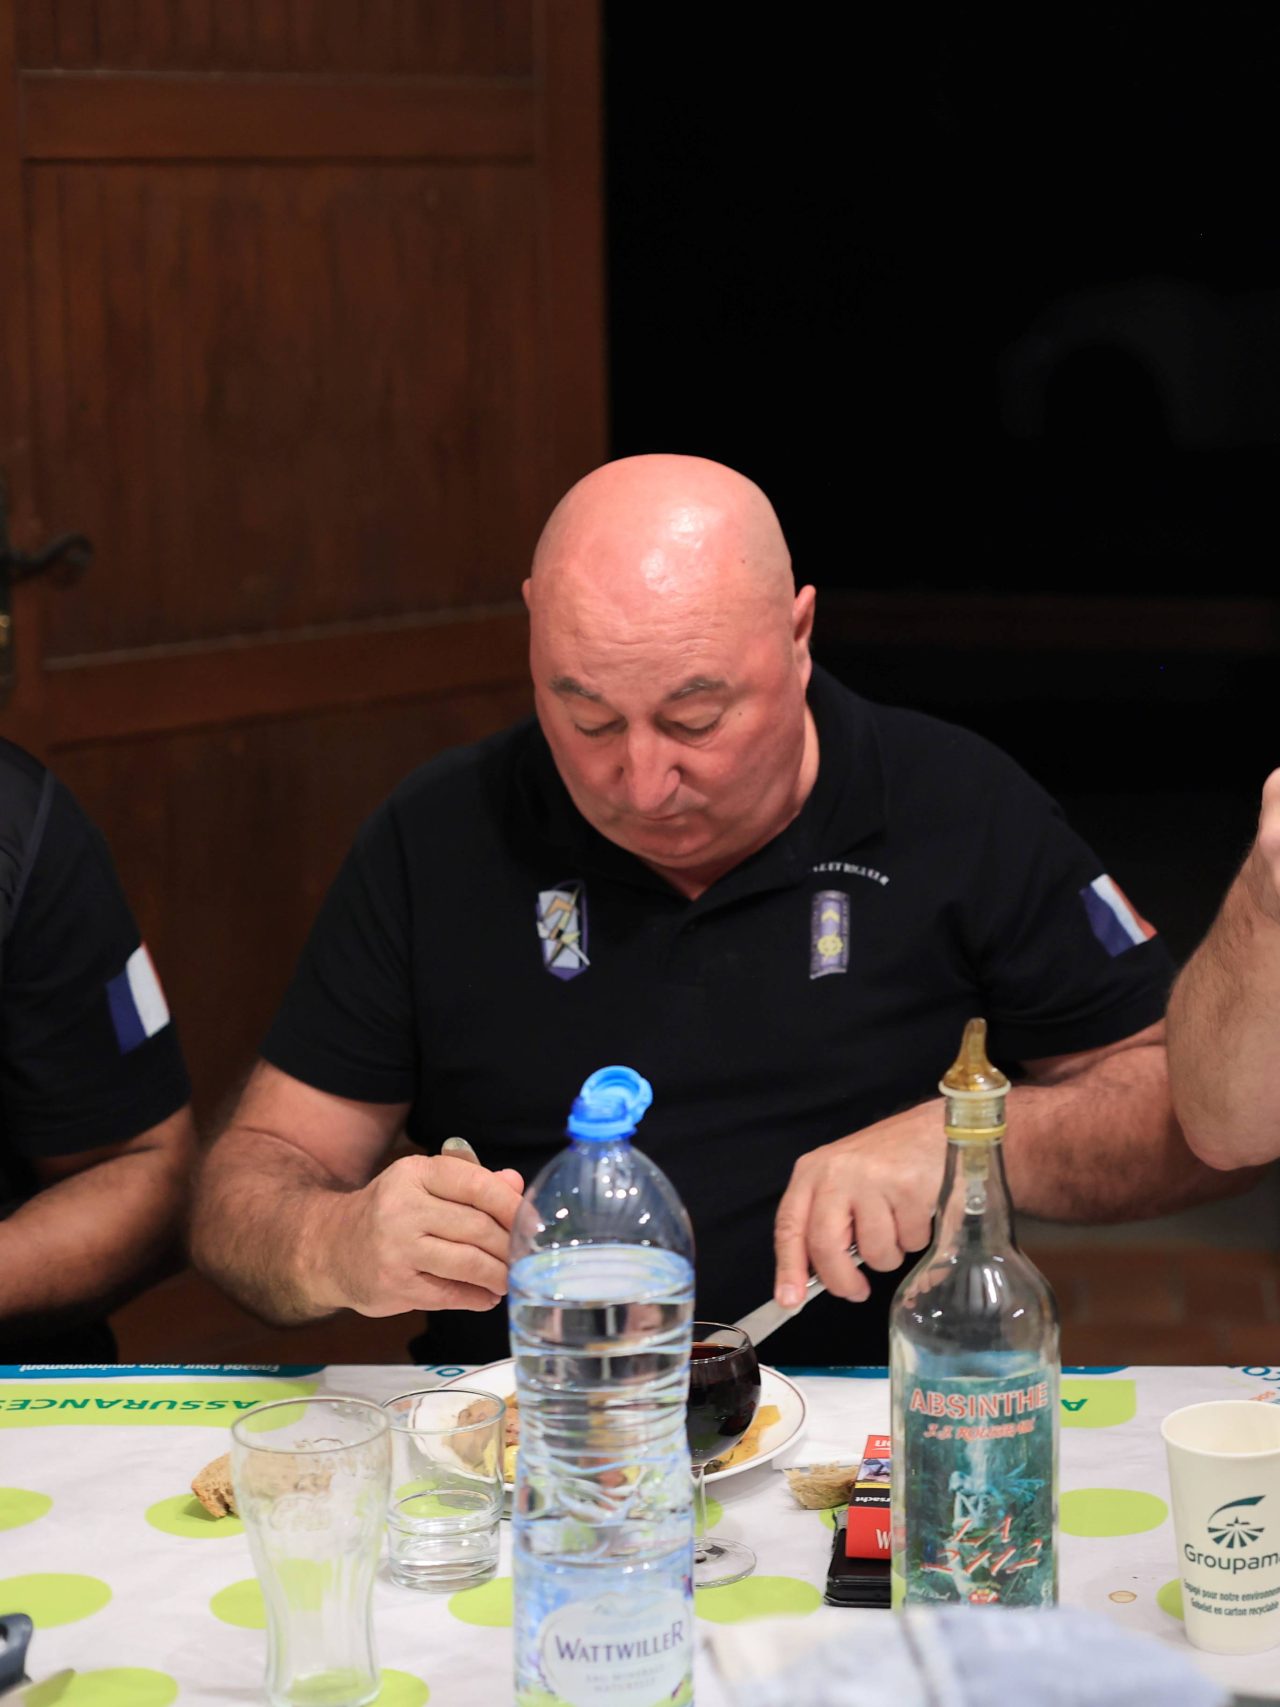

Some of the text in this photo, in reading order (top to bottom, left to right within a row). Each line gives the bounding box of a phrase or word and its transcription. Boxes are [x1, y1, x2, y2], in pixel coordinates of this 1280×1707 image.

[0, 1398, 260, 1411] ASSURANCE
[909, 1382, 1048, 1419] ABSINTHE
[555, 1620, 684, 1663] WATTWILLER
